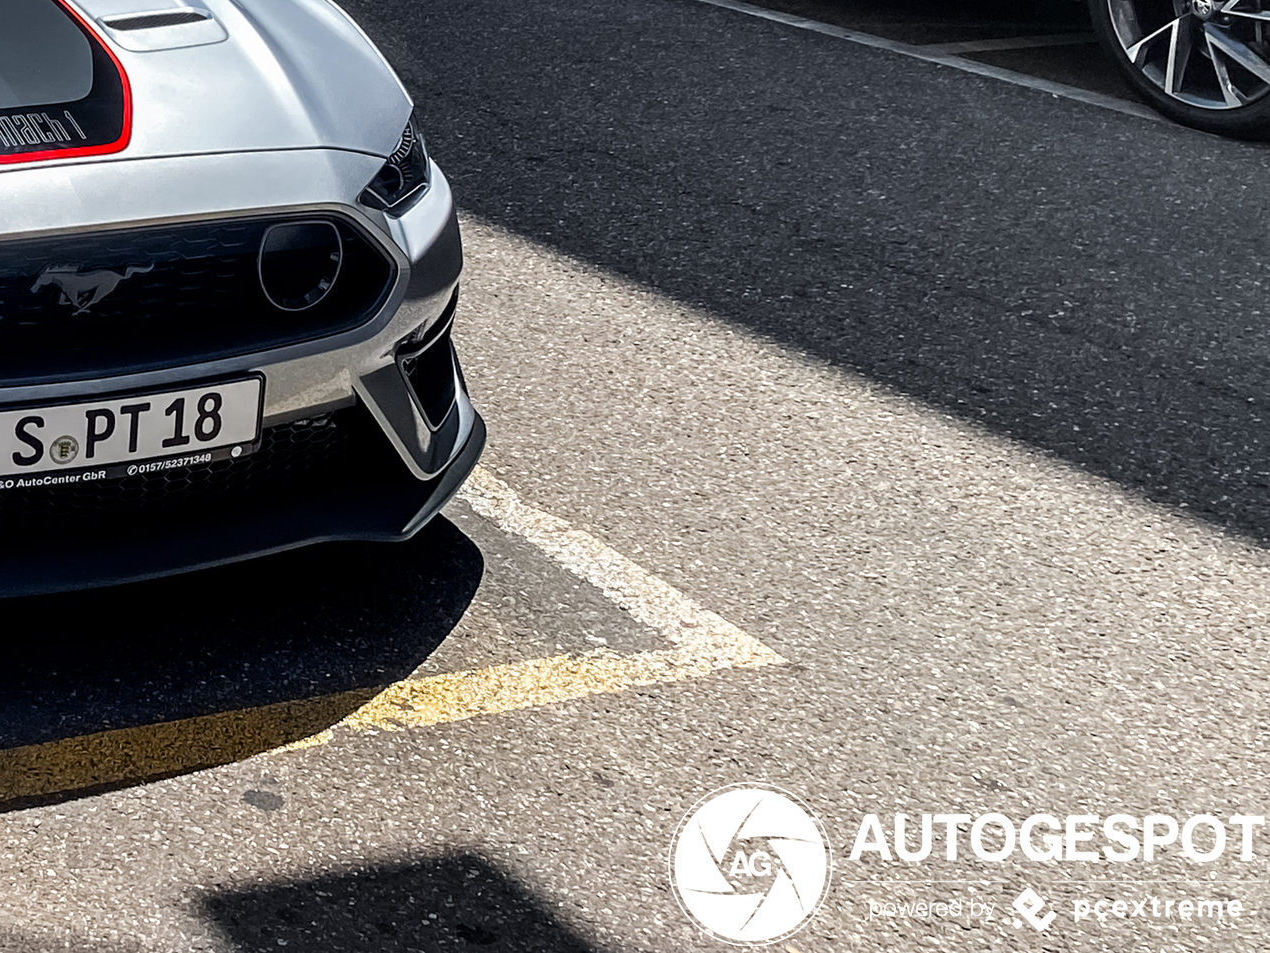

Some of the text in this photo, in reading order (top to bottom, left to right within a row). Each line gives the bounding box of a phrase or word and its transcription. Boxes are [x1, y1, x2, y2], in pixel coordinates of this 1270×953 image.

[11, 392, 223, 467] S PT 18
[16, 474, 81, 489] AutoCenter
[82, 470, 107, 482] GbR
